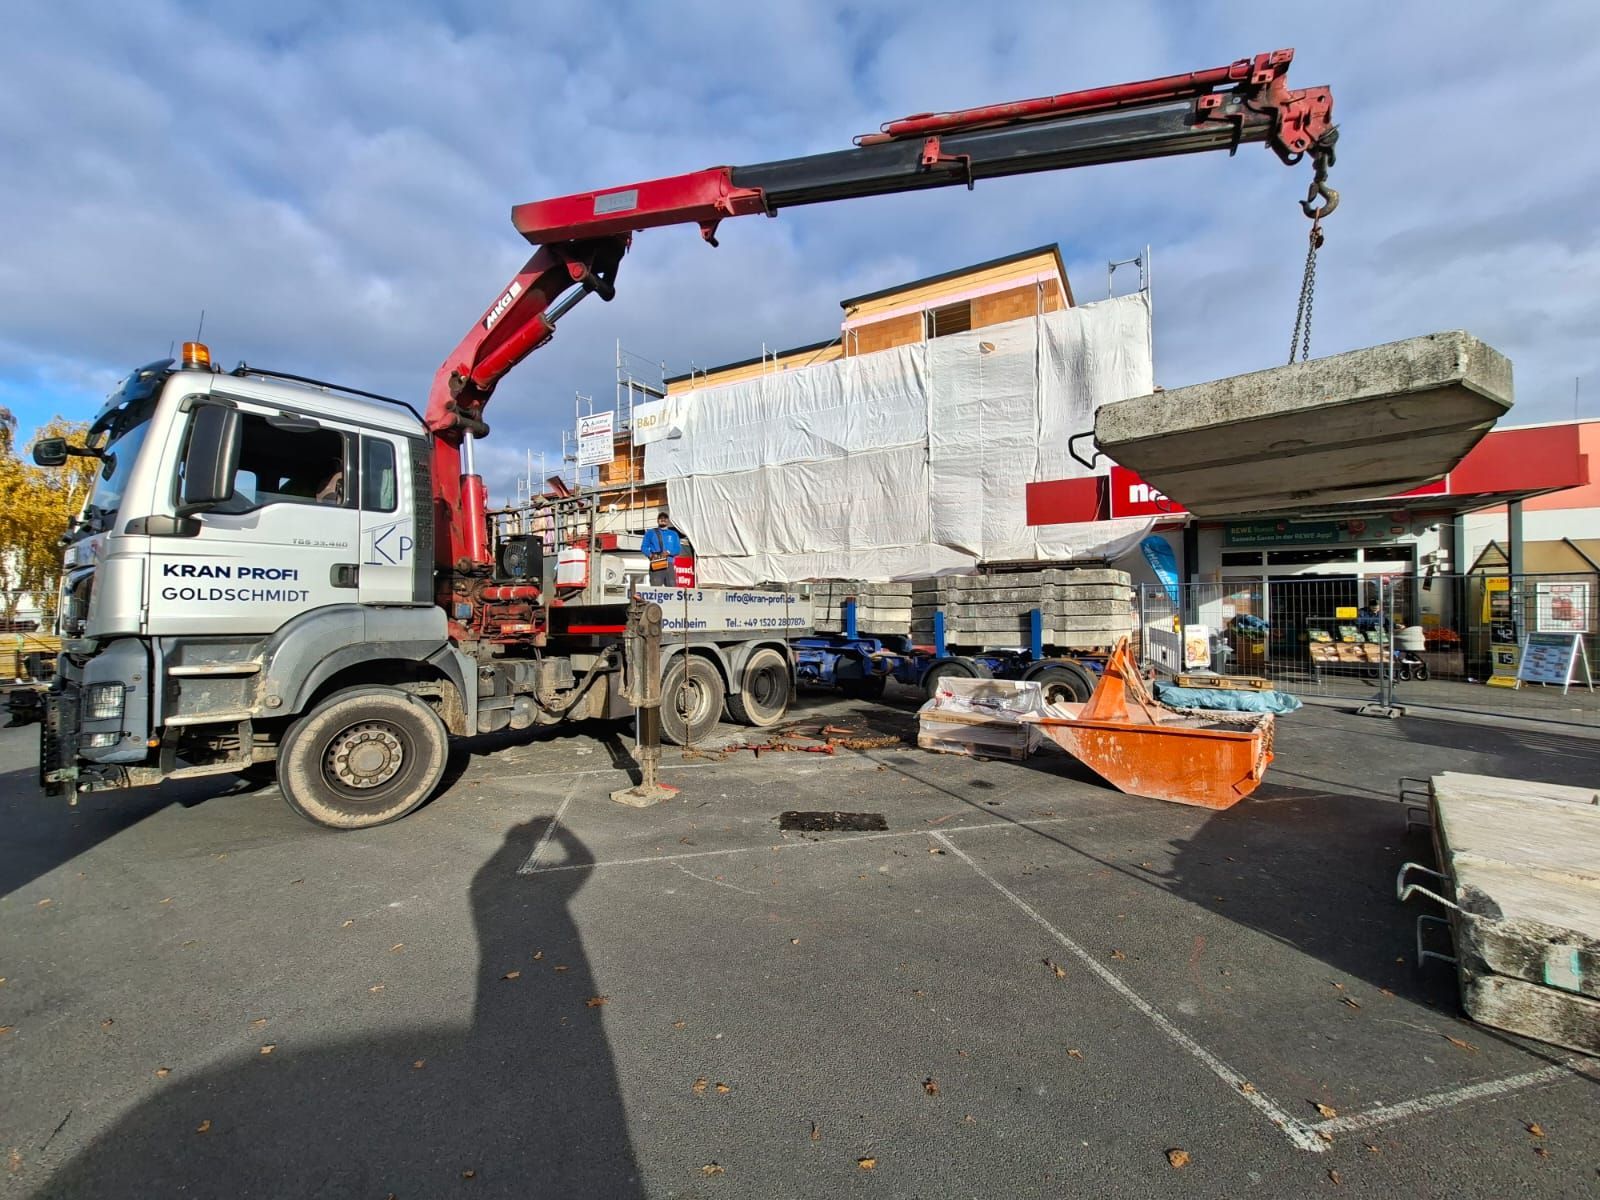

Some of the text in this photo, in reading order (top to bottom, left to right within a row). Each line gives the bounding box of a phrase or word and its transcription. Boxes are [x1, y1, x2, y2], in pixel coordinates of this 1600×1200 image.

[486, 292, 513, 330] MKG
[637, 415, 656, 428] B&D
[163, 564, 298, 580] KRAN PROFI
[162, 587, 309, 602] GOLDSCHMIDT
[677, 590, 694, 601] Str.
[697, 591, 703, 601] 3
[662, 617, 707, 629] Pohlheim
[726, 618, 742, 628] Tel.:
[744, 618, 758, 628] +49
[759, 618, 777, 627] 1520
